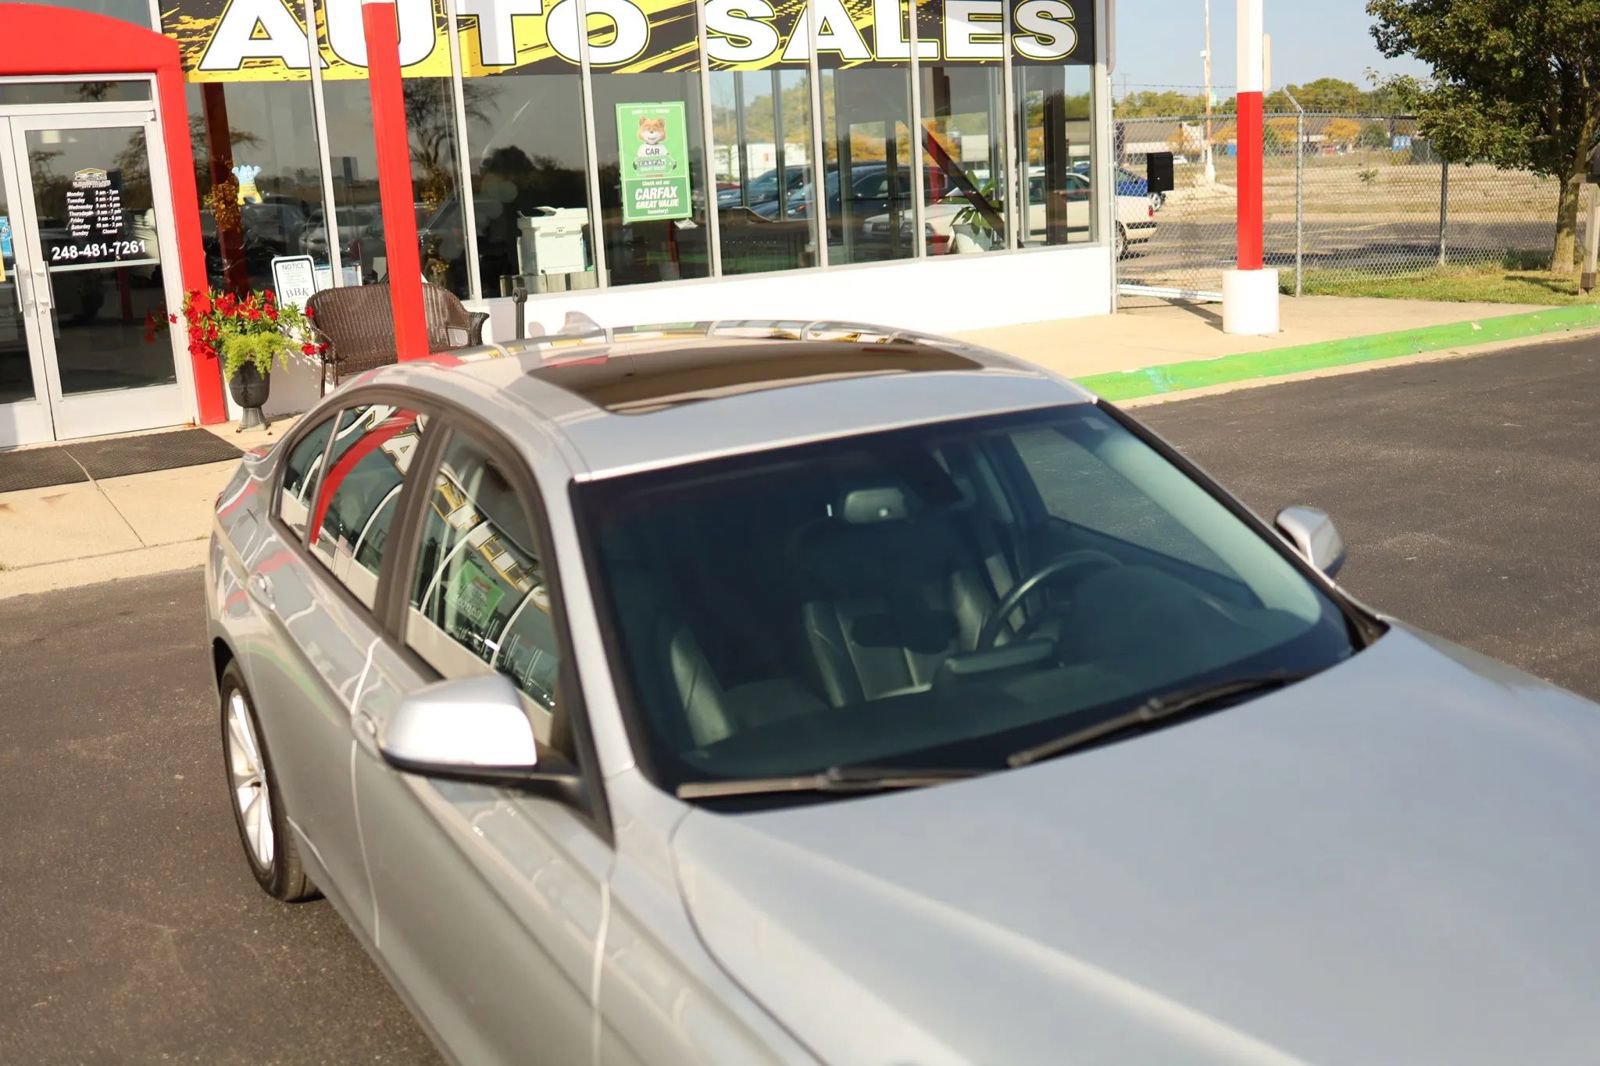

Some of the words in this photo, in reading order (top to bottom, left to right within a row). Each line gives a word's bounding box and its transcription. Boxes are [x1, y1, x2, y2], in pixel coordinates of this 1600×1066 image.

[197, 0, 650, 71] AUTO
[705, 0, 1078, 63] SALES
[645, 148, 660, 156] CAR
[635, 186, 678, 201] CARFAX
[635, 200, 658, 210] GREAT
[658, 198, 680, 208] VALUE
[51, 240, 146, 260] 248-481-7261
[281, 262, 304, 271] NOTICE
